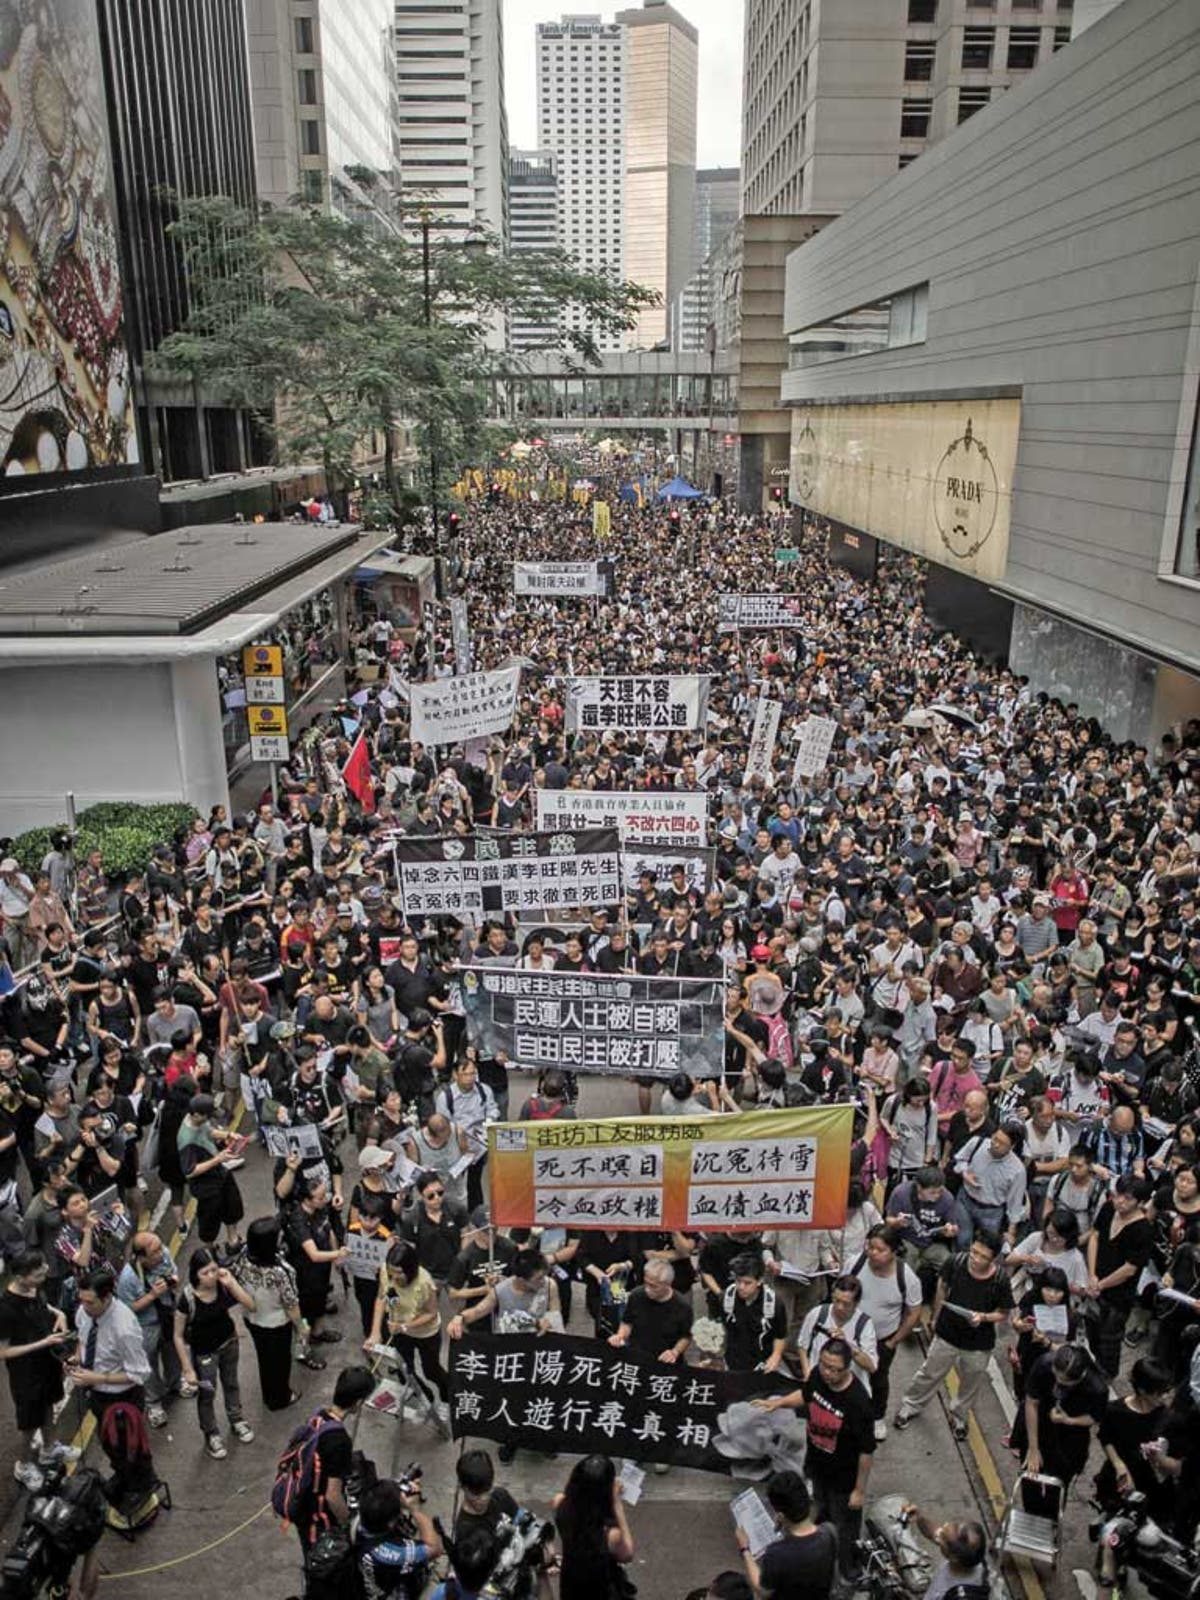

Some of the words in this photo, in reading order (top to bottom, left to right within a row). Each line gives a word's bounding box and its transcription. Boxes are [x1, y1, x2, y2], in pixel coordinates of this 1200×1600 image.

[538, 24, 560, 33] Bank
[571, 24, 604, 33] America
[946, 477, 981, 504] PRADA
[600, 679, 670, 702] 天理不容
[582, 704, 687, 727] 還李旺陽公道
[543, 813, 617, 831] 黑獄廿一年
[625, 815, 700, 832] 不改六四心
[405, 857, 618, 883] 悼念六四鐵漢李旺陽先生
[406, 891, 482, 910] 含冤待雪
[504, 884, 617, 906] 要求徹查死因
[514, 1002, 679, 1033] 民運人士被自殺
[516, 1035, 679, 1071] 自由民主被打壓
[1075, 1103, 1098, 1114] AON
[693, 1144, 814, 1174] 沉冤待雪
[537, 1194, 660, 1219] 冷血政權
[691, 1189, 812, 1217] 血債血償
[456, 1350, 716, 1405] 李旺陽死得冤枉
[455, 1391, 709, 1448] 萬人遊行尋真相
